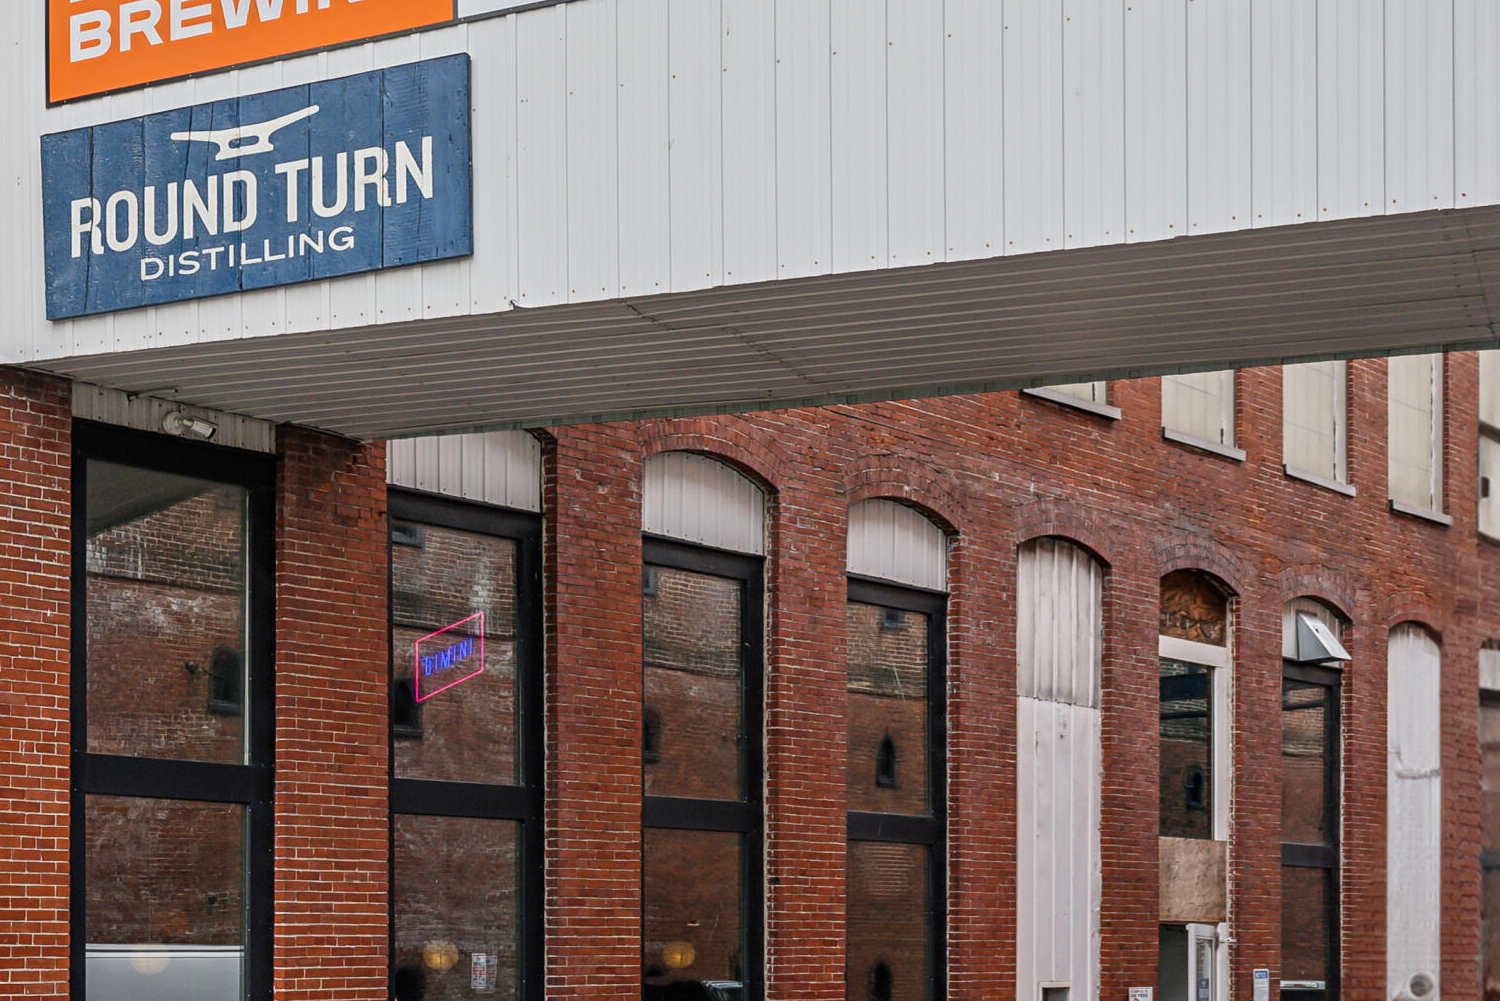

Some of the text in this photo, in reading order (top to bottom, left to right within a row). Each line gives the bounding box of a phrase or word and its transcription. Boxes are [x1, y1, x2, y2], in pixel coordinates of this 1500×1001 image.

[70, 135, 434, 260] ROUND TURN
[139, 225, 356, 282] DISTILLING
[422, 635, 474, 677] BIMINI
